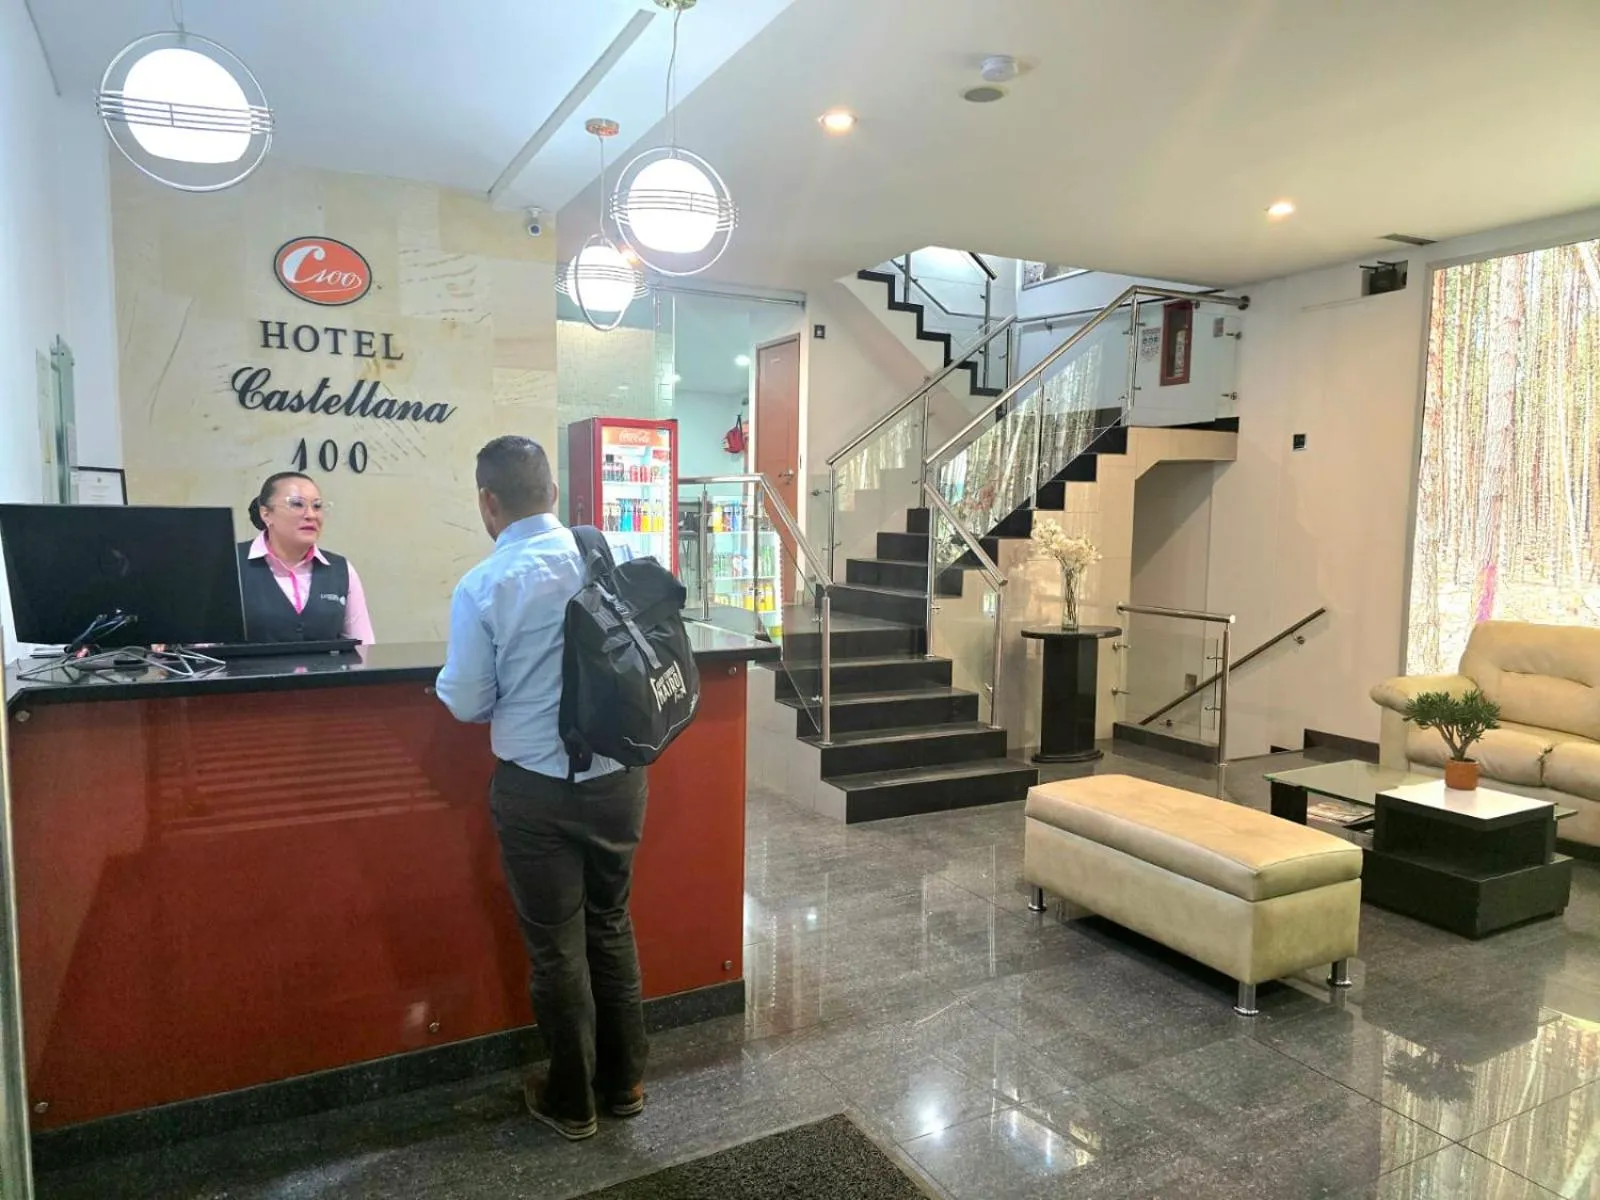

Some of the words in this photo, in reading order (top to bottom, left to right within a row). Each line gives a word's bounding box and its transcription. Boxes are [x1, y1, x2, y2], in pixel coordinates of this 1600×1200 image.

[258, 319, 405, 361] HOTEL
[230, 366, 458, 424] Castellana
[290, 437, 369, 474] 100
